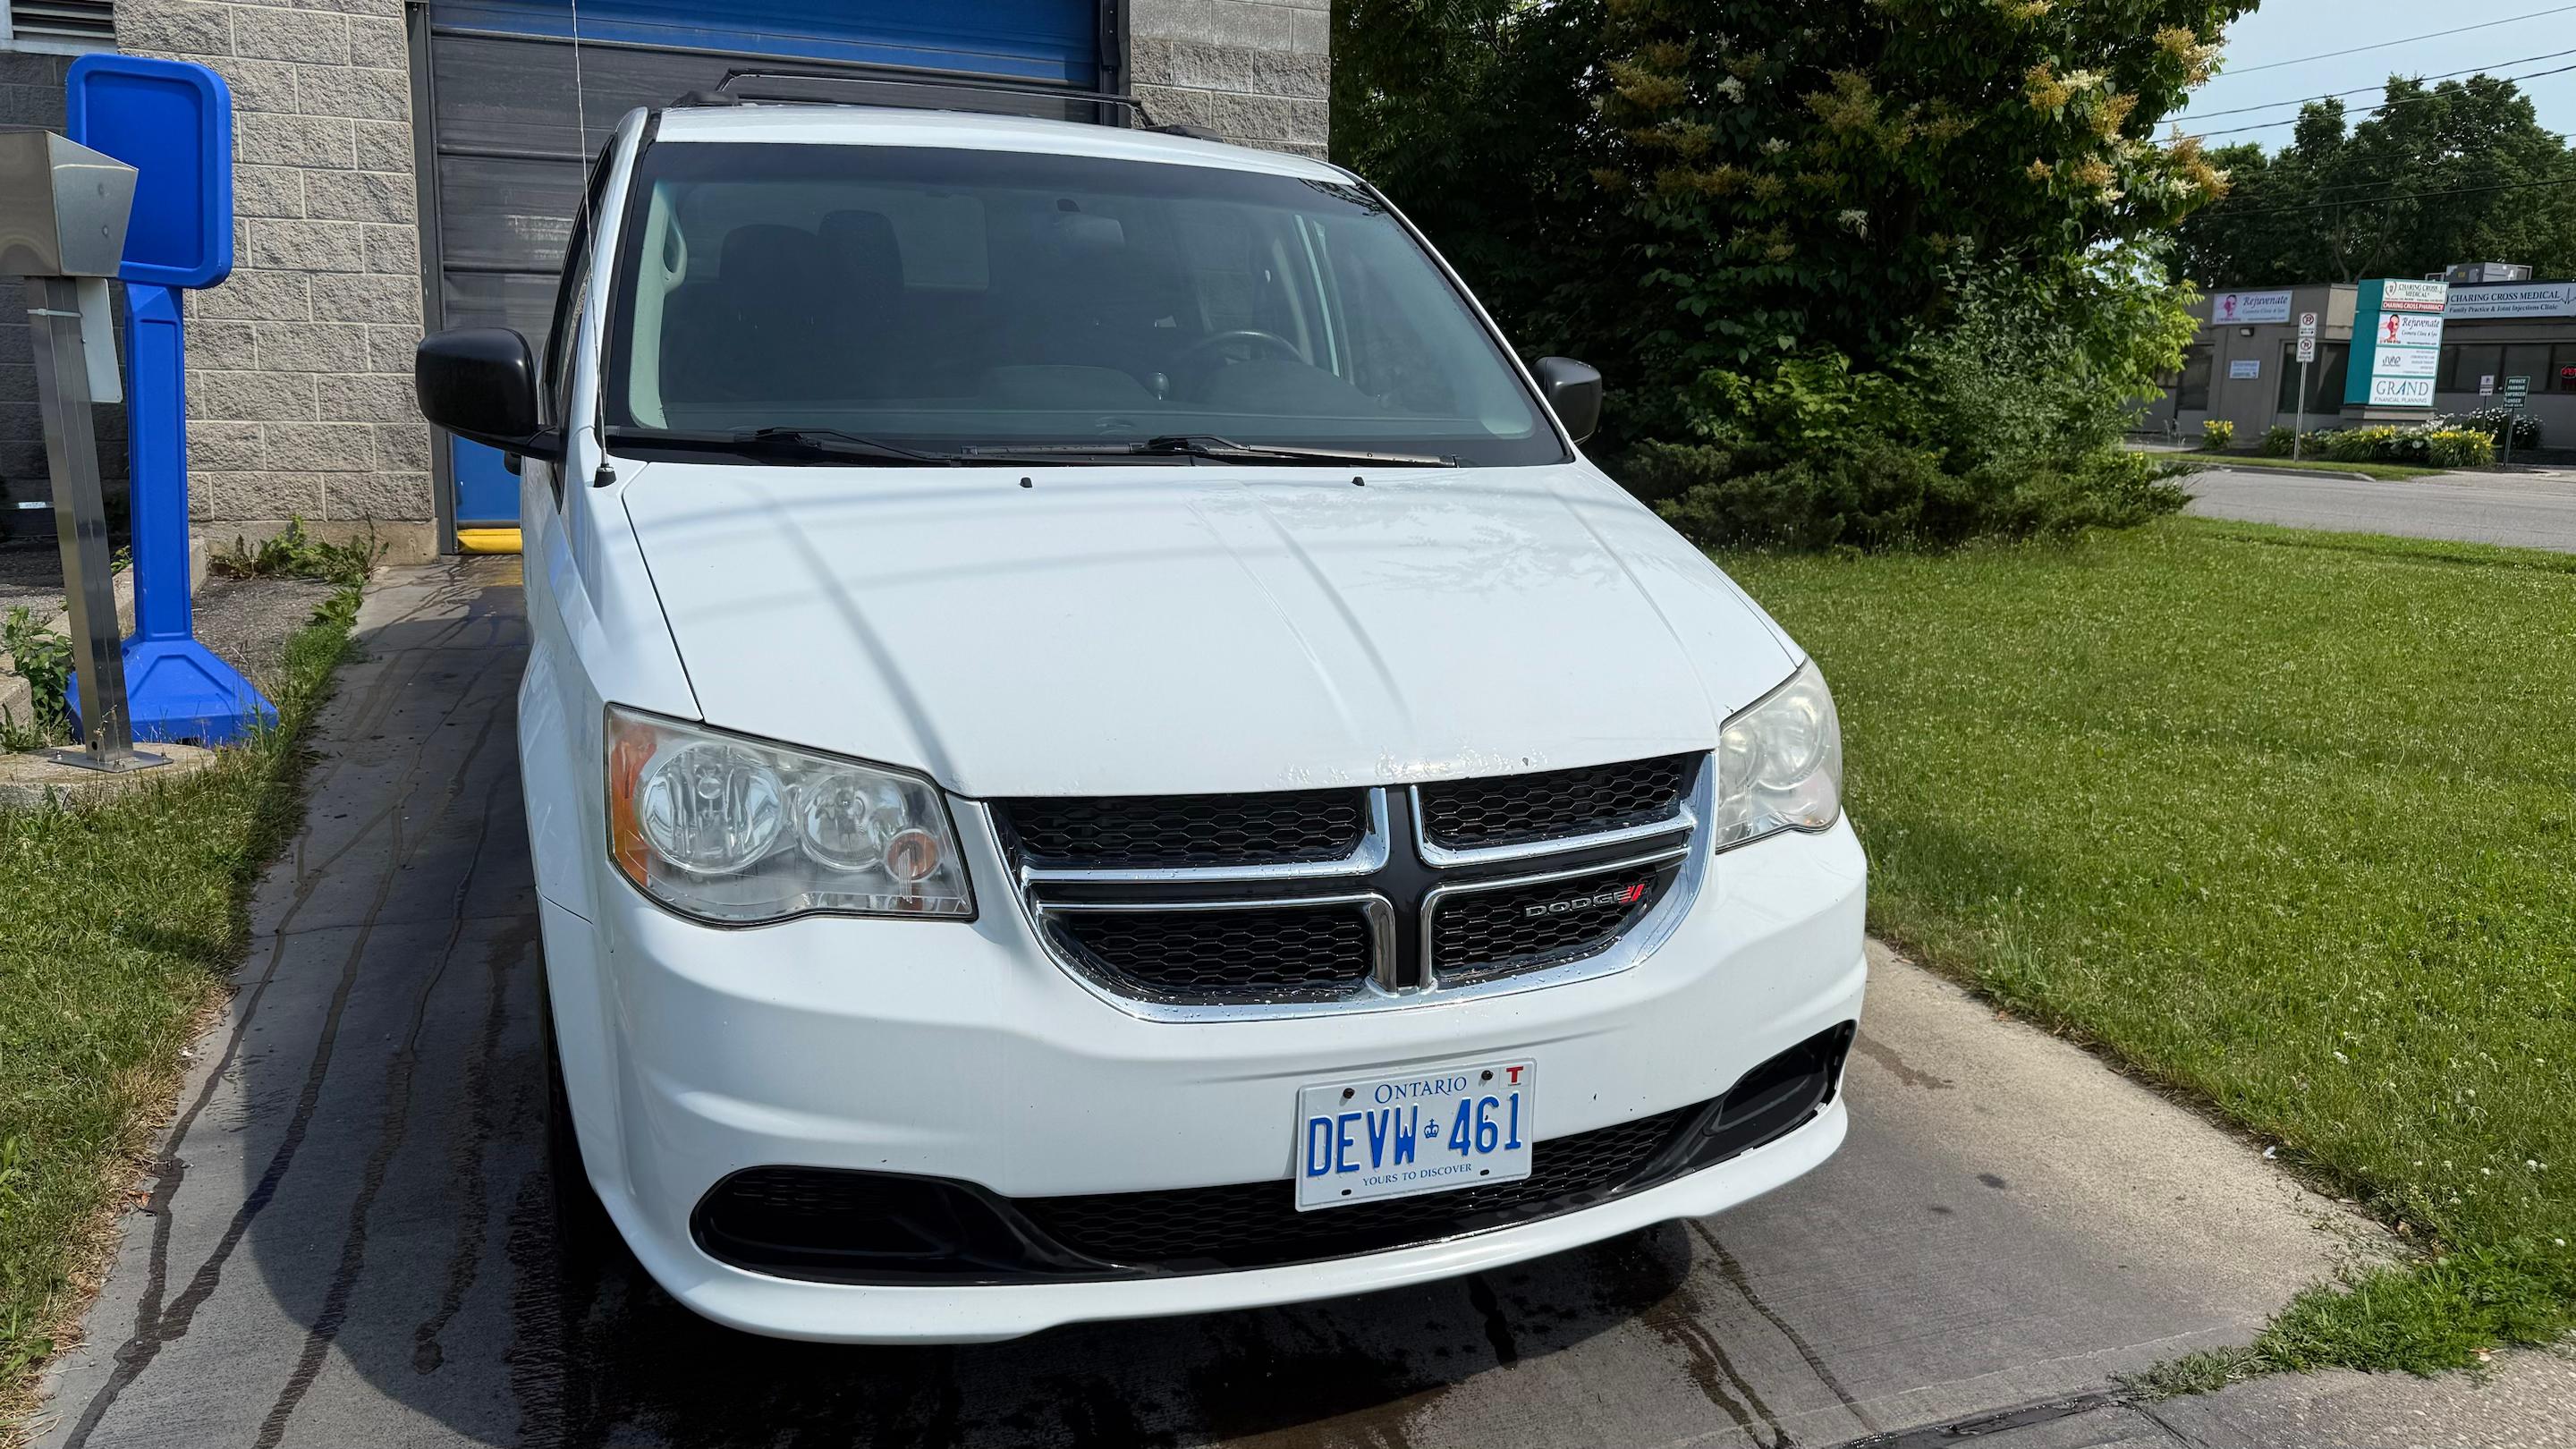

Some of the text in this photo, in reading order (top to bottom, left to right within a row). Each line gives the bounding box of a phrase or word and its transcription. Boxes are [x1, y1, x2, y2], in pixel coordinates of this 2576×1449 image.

[2398, 284, 2438, 292] CHARING CROSS
[2243, 296, 2288, 309] Rejuvenate
[2451, 293, 2489, 302] CHARING
[2491, 292, 2518, 301] CROSS
[2520, 291, 2559, 301] MEDICAL
[2383, 301, 2403, 309] CHARING
[2419, 303, 2445, 311] PHARMACY
[2449, 306, 2468, 314] Family
[2512, 304, 2539, 313] Injections
[2402, 317, 2440, 330] Rejuvenate
[2376, 380, 2428, 395] GRAND
[1525, 886, 1633, 917] DODGE
[1506, 1066, 1524, 1083] T
[1375, 1077, 1467, 1104] ONTARIO
[1306, 1091, 1522, 1177] DEVW 461
[1362, 1163, 1472, 1187] YOURS TO DISCOVER
